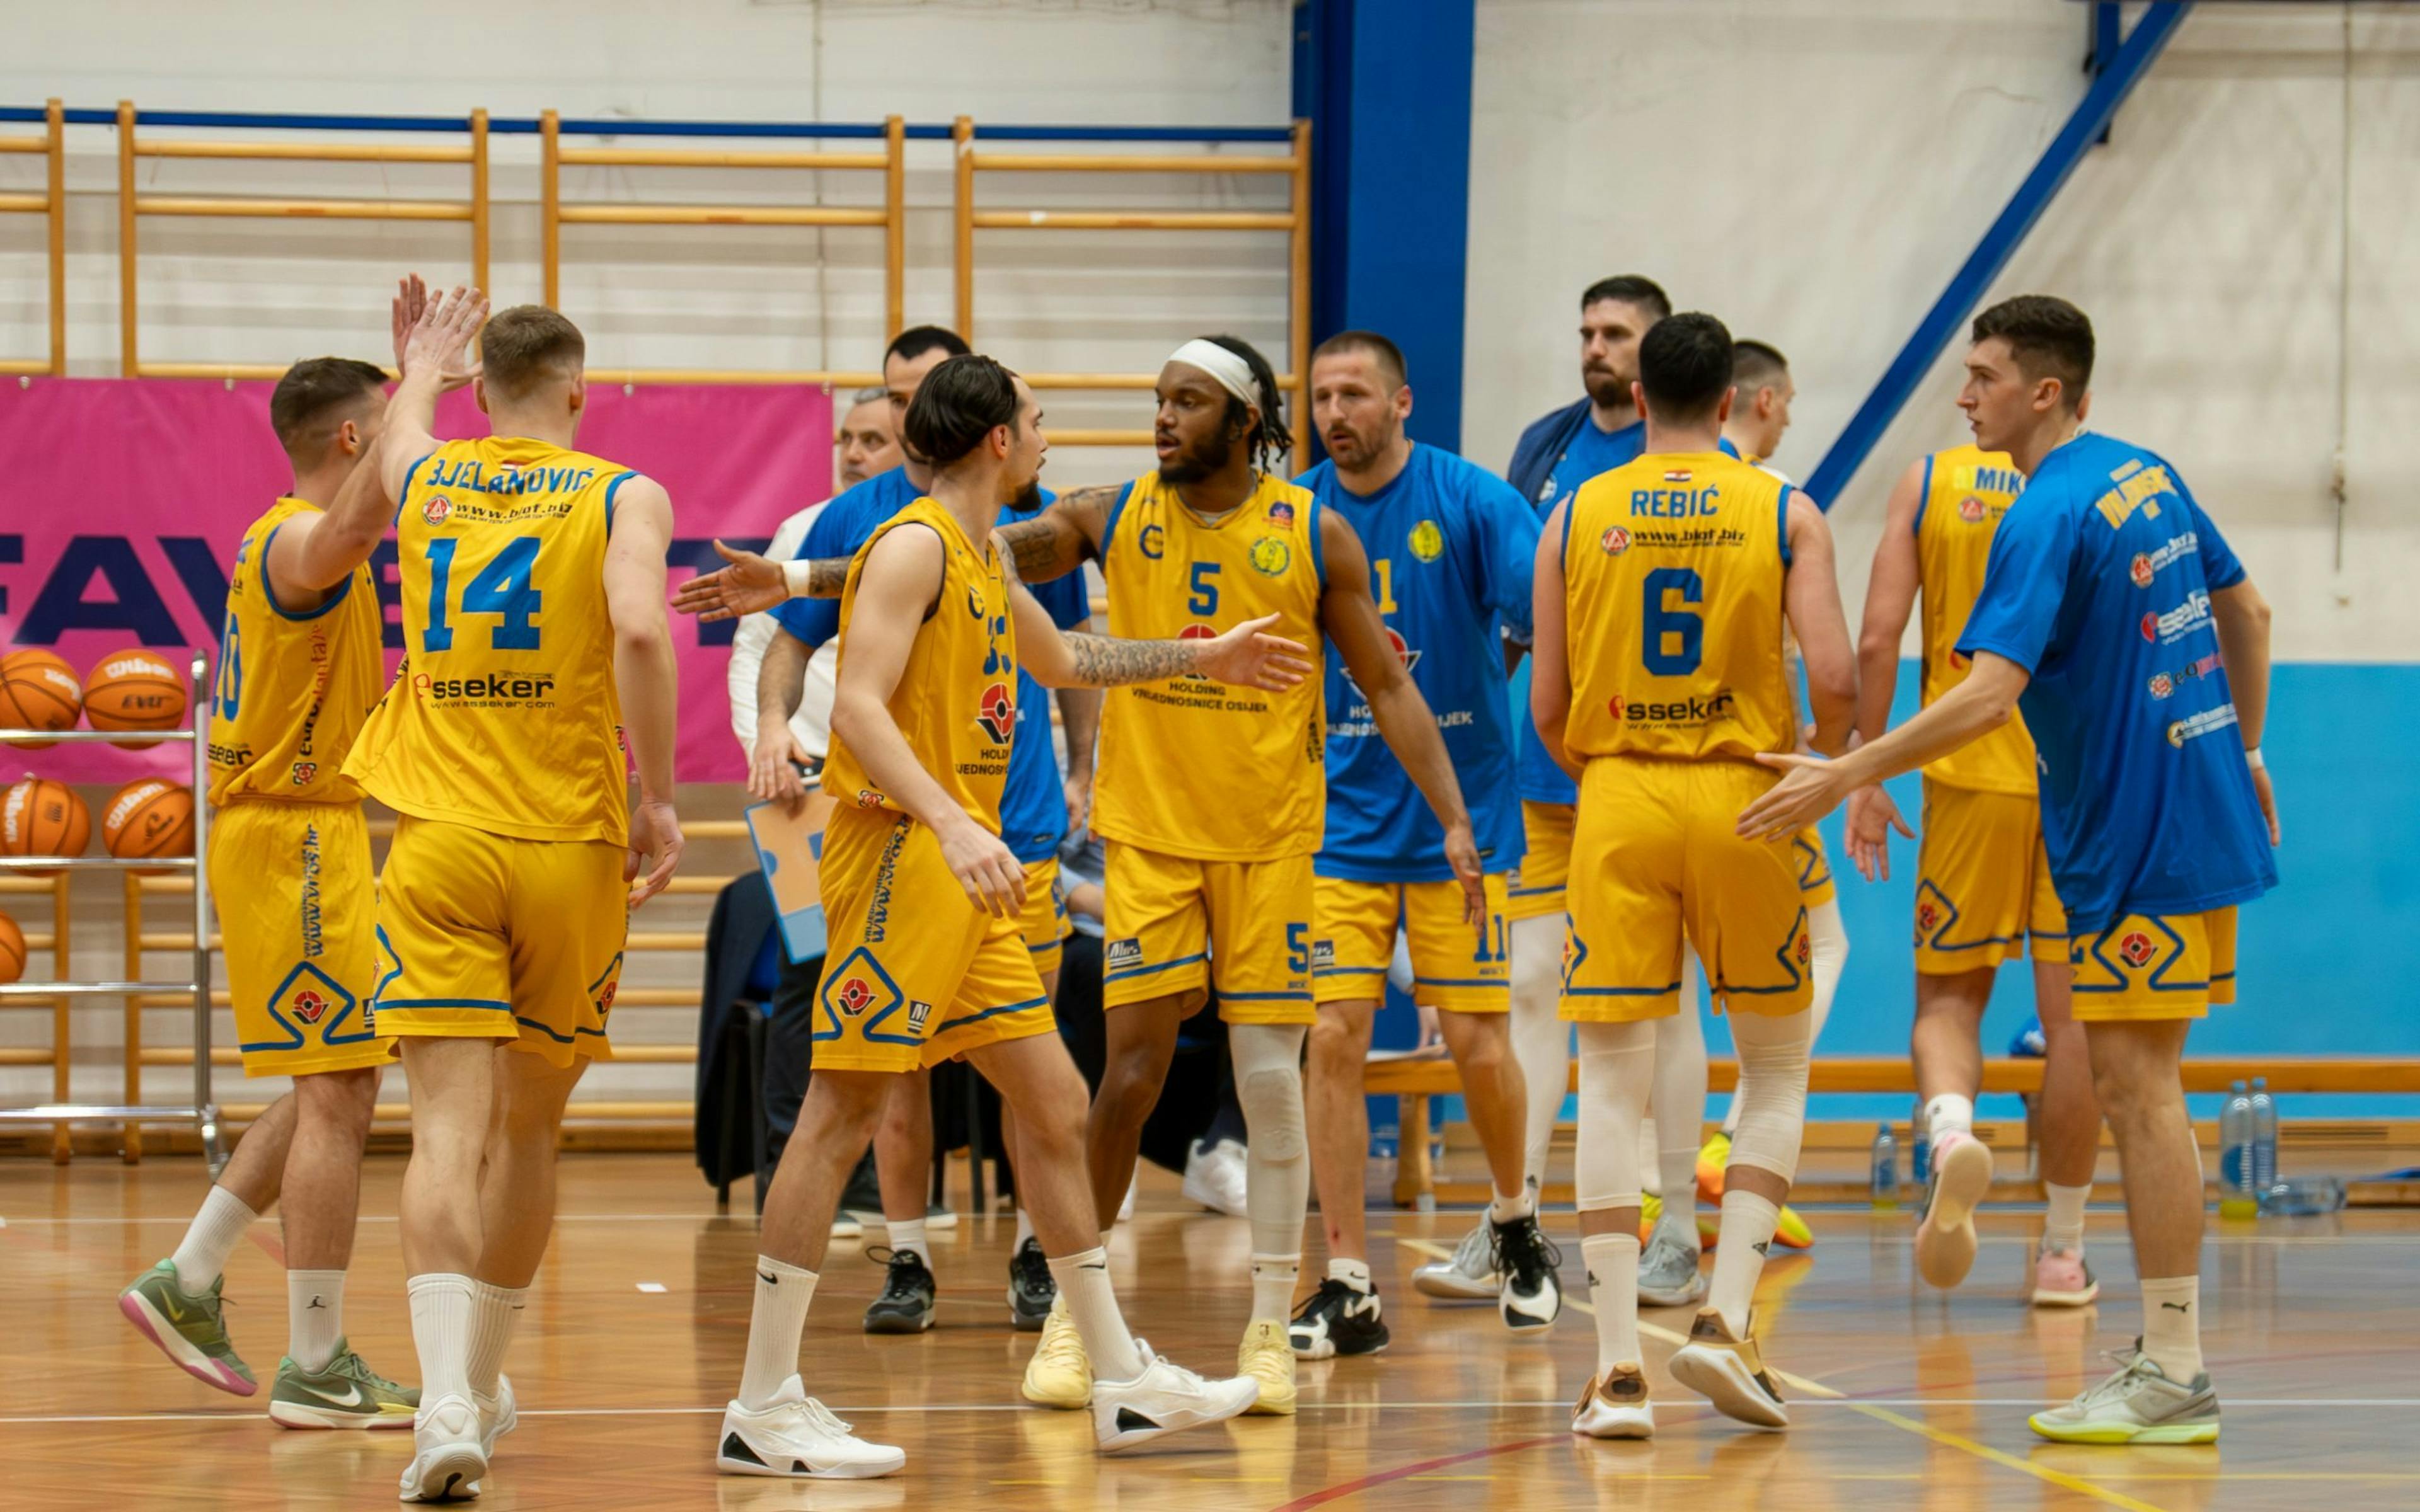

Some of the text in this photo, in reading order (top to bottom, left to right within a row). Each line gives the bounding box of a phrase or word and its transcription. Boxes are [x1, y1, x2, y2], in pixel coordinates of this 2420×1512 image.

[1630, 483, 1719, 518] REBIĆ
[1975, 466, 2022, 495] MIK
[422, 536, 542, 653] 14
[1189, 561, 1221, 616] 5
[1374, 559, 1397, 614] 1
[1642, 568, 1703, 677] 6
[413, 673, 555, 700] esseker
[1169, 682, 1226, 696] HOLDING
[1286, 922, 1309, 974] 5
